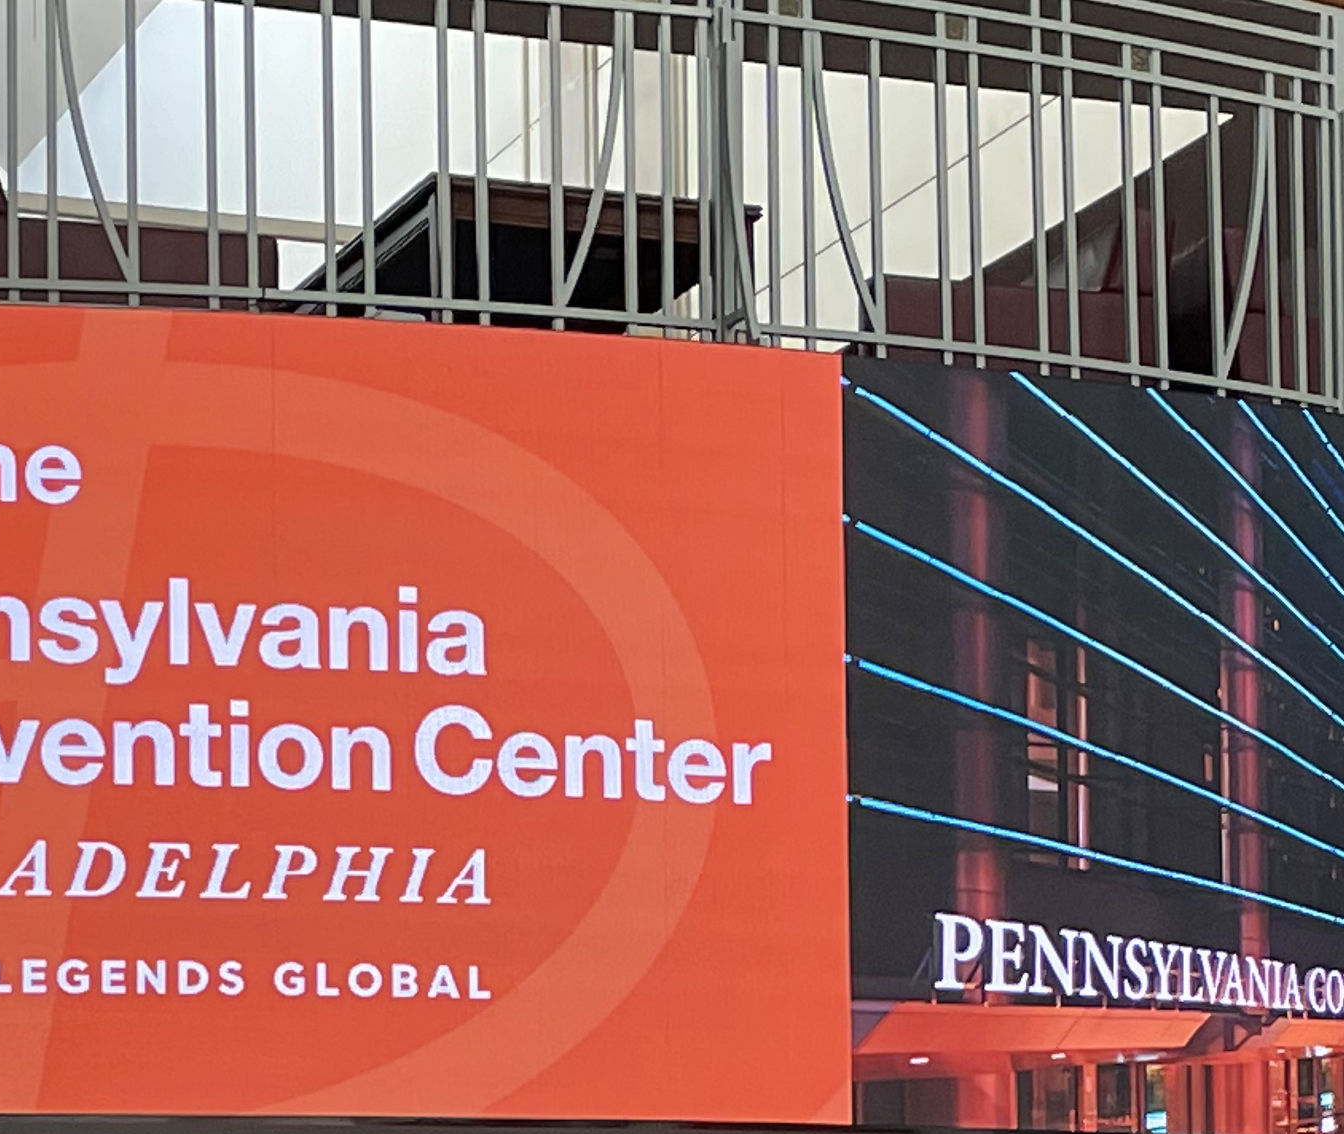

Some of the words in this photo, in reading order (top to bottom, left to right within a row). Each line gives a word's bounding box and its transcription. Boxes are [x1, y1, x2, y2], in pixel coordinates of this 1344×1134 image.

[414, 704, 773, 805] Center
[273, 961, 492, 1000] GLOBAL
[933, 911, 1304, 1013] PENNSYLVANIA
